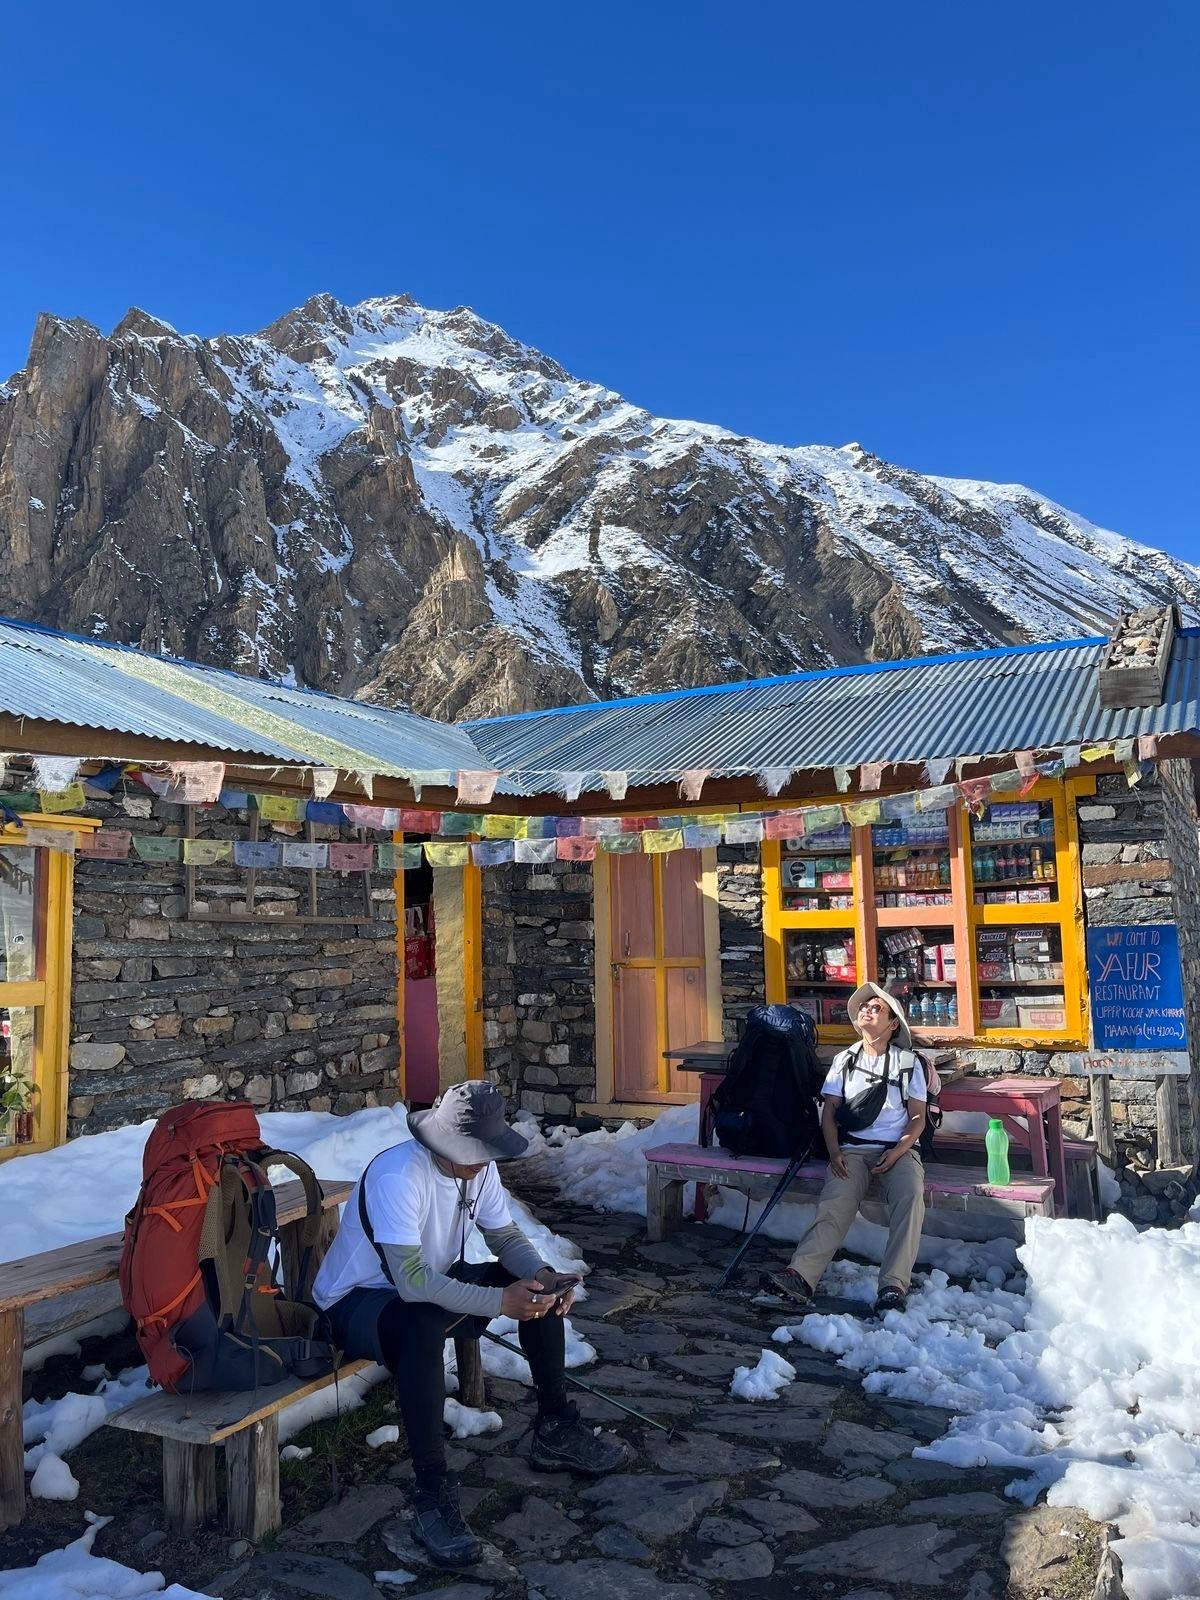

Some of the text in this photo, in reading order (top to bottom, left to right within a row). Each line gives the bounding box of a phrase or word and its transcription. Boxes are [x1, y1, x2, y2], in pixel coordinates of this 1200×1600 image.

[1150, 930, 1160, 946] TO
[1094, 952, 1162, 982] YAFUR
[1094, 984, 1161, 1001] RESTAURANT
[1096, 1005, 1121, 1018] UPPER
